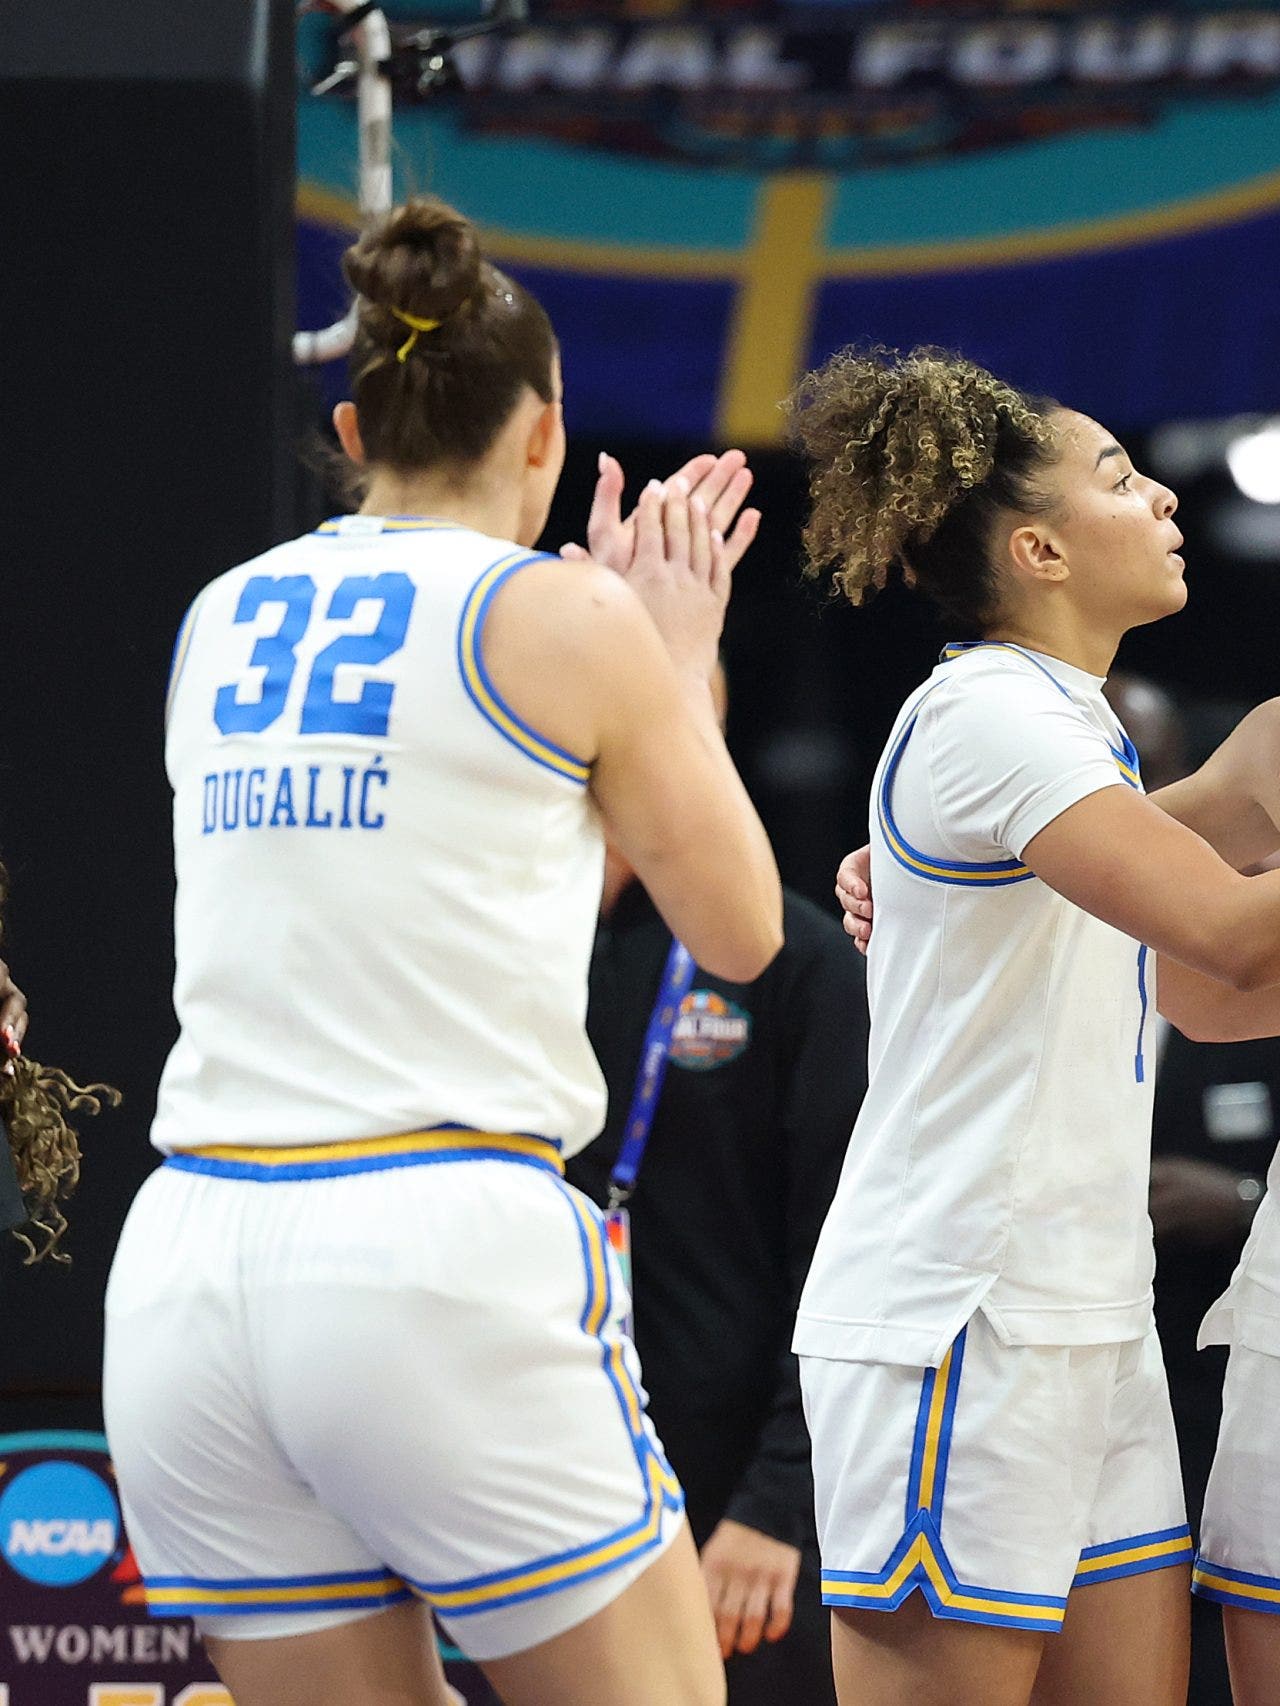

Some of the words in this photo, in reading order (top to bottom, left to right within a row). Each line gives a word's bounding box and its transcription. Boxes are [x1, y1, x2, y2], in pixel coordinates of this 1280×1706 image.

[213, 570, 417, 736] 32
[202, 755, 388, 835] DUGALIĆ
[7, 1518, 117, 1557] NCAA
